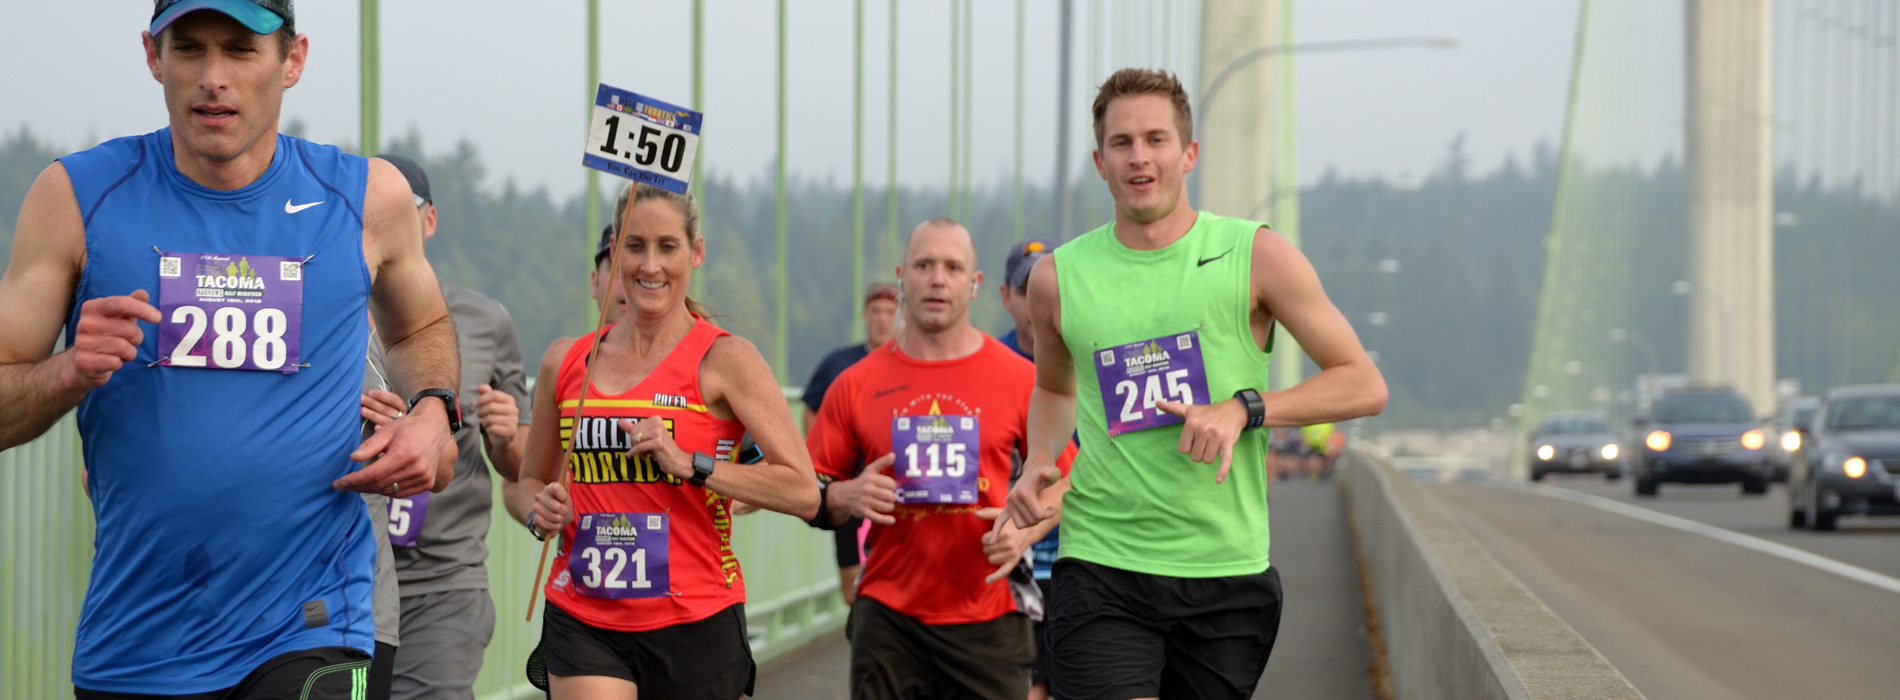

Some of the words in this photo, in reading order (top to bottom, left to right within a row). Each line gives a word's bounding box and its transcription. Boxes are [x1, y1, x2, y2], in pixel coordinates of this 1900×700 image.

[600, 115, 686, 173] 1:50
[195, 275, 266, 289] TACOMA
[171, 305, 287, 370] 288
[1124, 350, 1170, 367] TACOMA
[653, 393, 687, 408] PACER
[1115, 368, 1194, 423] 245
[904, 443, 967, 478] 115
[596, 526, 638, 536] TACOMA
[581, 547, 652, 588] 321
